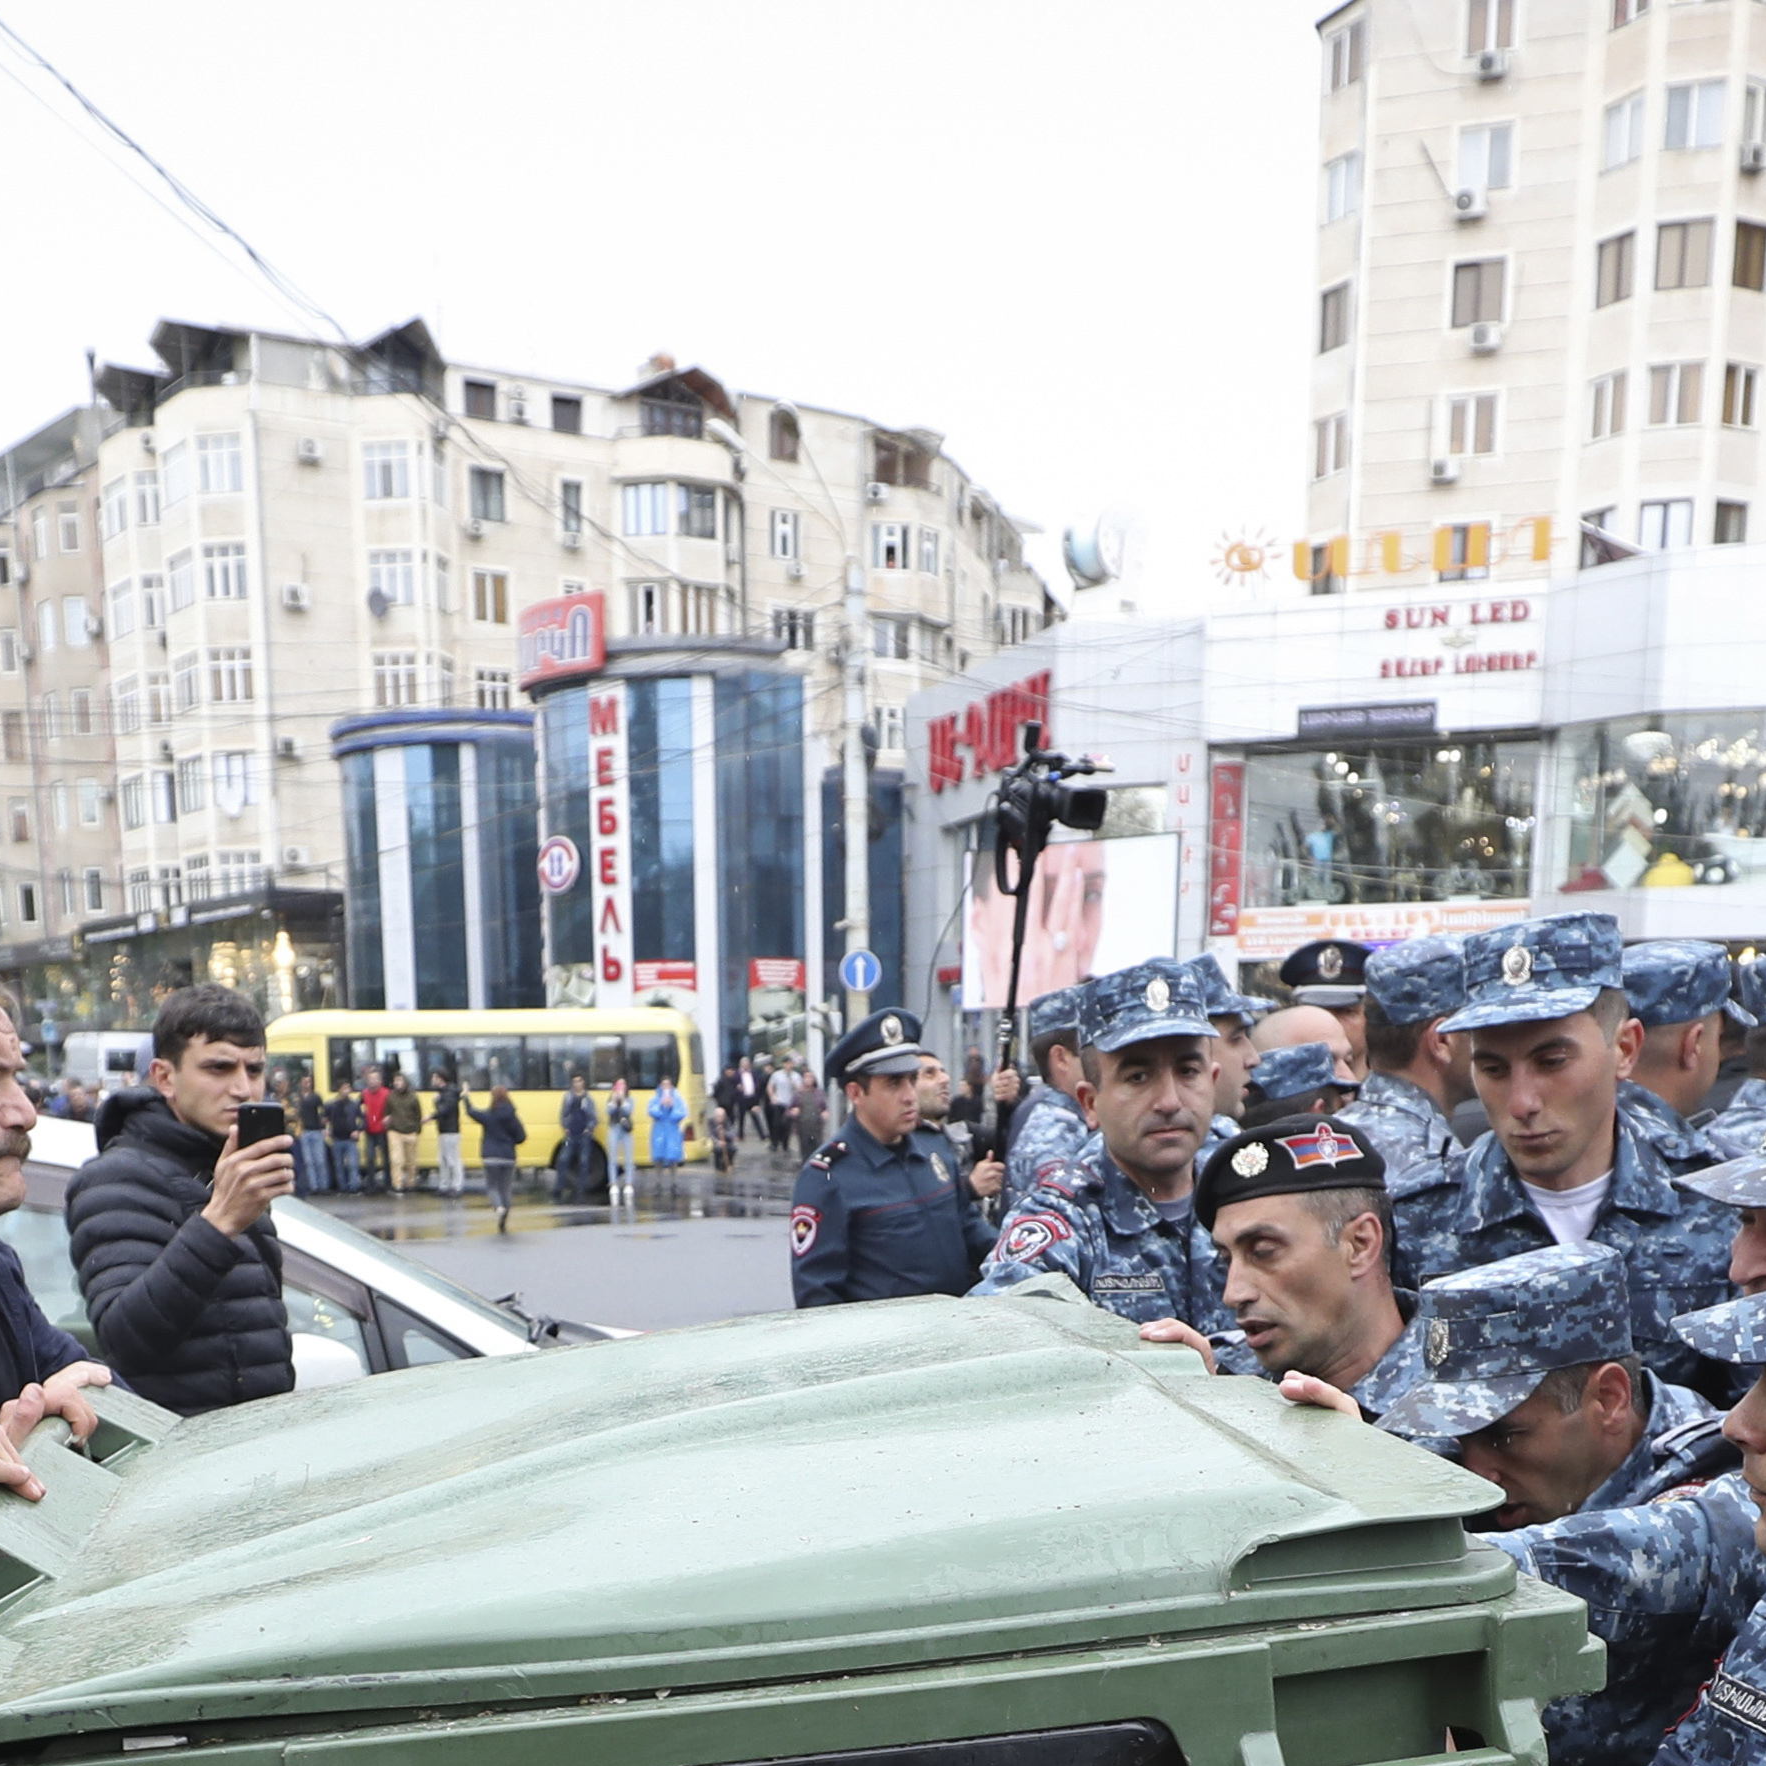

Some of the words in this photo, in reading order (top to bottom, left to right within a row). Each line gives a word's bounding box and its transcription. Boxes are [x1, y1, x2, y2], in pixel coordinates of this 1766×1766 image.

[1385, 605, 1450, 630] SUN
[1470, 599, 1531, 625] LED
[588, 696, 622, 982] МЕБЕЛЬ
